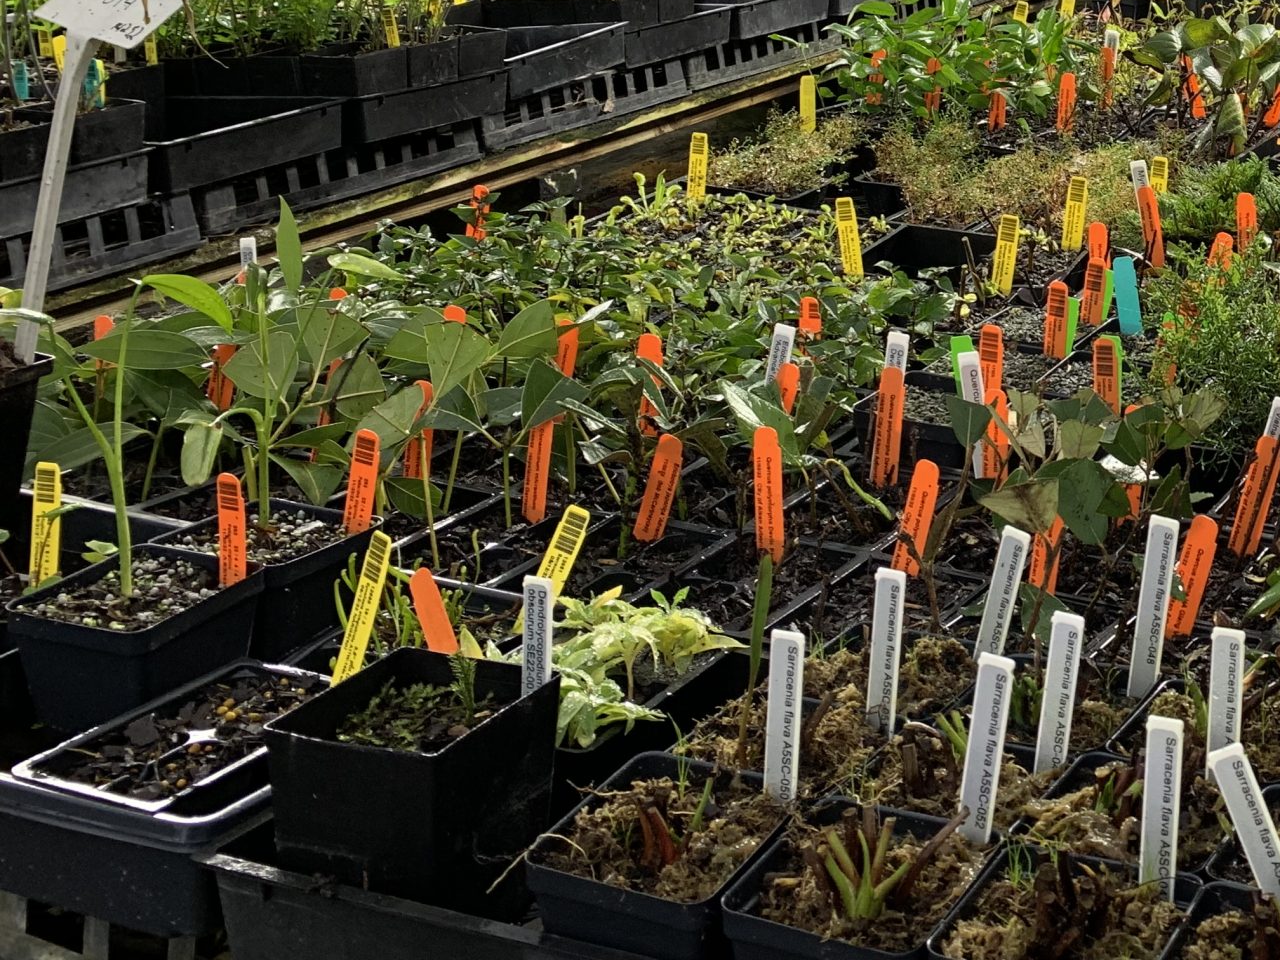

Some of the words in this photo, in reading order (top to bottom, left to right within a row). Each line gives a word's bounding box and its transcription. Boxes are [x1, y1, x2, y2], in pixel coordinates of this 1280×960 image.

[917, 491, 928, 518] Quercus
[1006, 544, 1022, 596] Sarracenia
[1157, 532, 1173, 585] Sarracenia
[1190, 548, 1205, 577] Quercus
[885, 584, 899, 645] Sarracenia
[998, 596, 1009, 621] flava
[1154, 586, 1165, 611] flava
[885, 645, 896, 671] flava
[990, 621, 1003, 654] A5SC-
[1061, 630, 1078, 691] Sarracenia
[1147, 612, 1160, 665] A5SC-048
[526, 643, 535, 690] SE22-00
[785, 645, 798, 708] Sarracenia
[1227, 642, 1240, 702] Sarracenia
[783, 708, 794, 741] flava
[989, 673, 1007, 742] Sarracenia
[1058, 692, 1071, 722] flava
[1226, 703, 1237, 733] flava
[779, 742, 793, 800] A5SC-050
[984, 740, 997, 770] flava
[1162, 736, 1177, 805] Sarracenia
[976, 769, 993, 829] A5SC-052
[1160, 807, 1174, 837] flava
[1232, 759, 1265, 825] Sarracenia
[1260, 823, 1276, 858] flava
